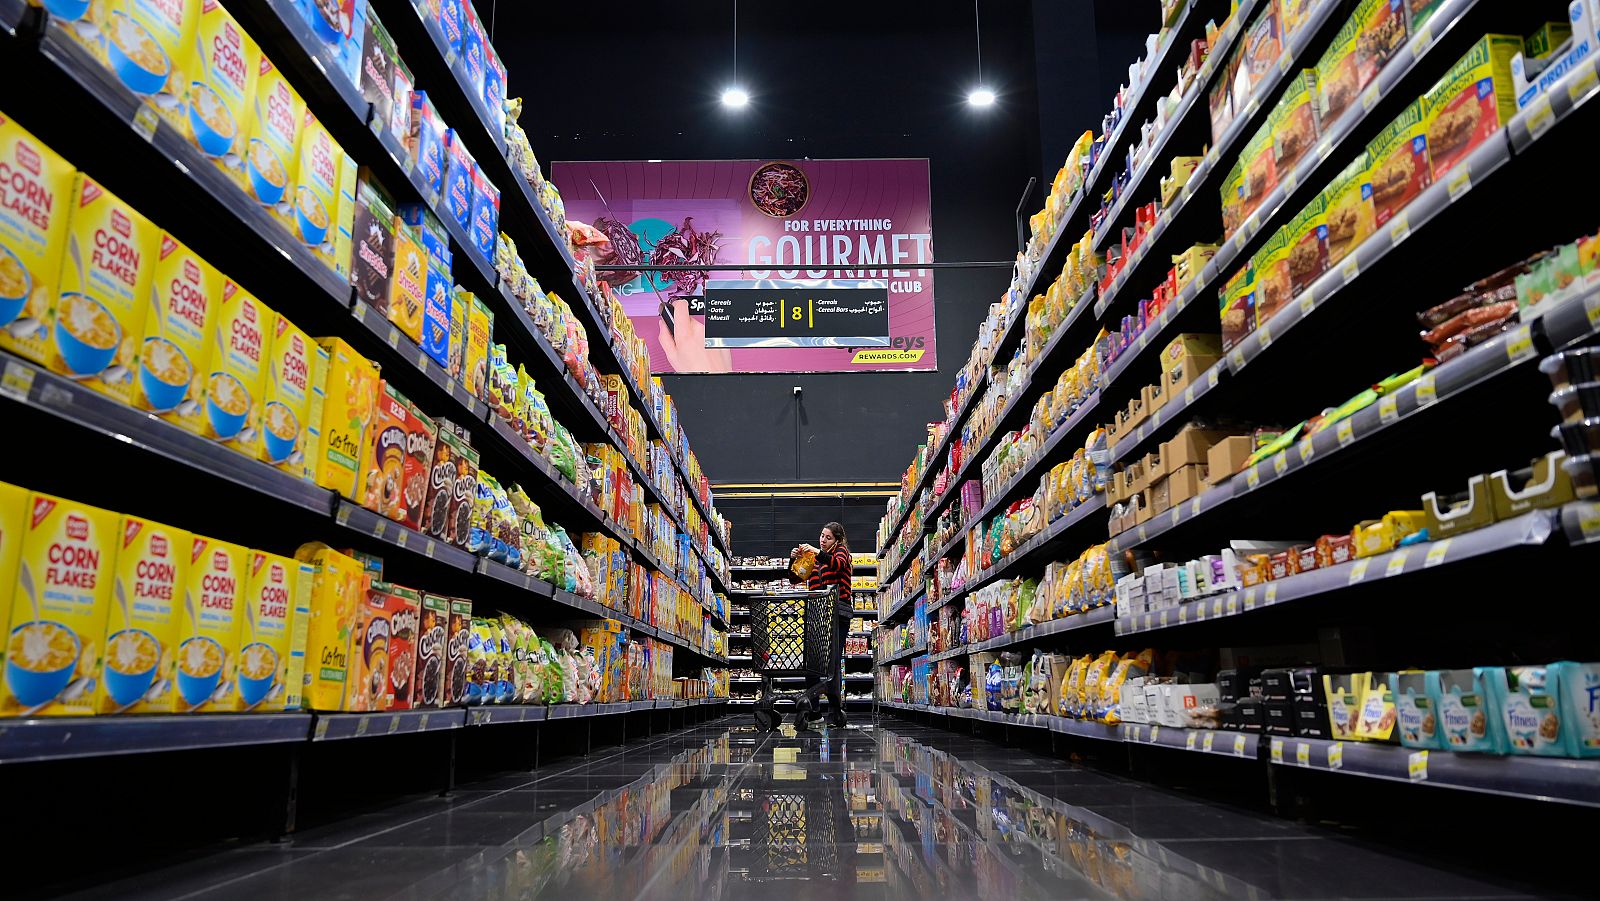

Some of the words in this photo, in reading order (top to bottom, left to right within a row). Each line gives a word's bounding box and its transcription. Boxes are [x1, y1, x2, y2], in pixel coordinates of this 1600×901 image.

[214, 35, 246, 79] CORN
[1539, 40, 1589, 90] PROTEIN
[213, 52, 245, 91] FLAKES
[268, 95, 295, 132] CORN
[312, 144, 335, 178] CORN
[0, 162, 52, 213] CORN
[785, 221, 809, 231] FOR
[814, 219, 892, 231] EVERYTHING
[95, 228, 139, 270] CORN
[749, 233, 930, 279] GOURMET
[92, 249, 136, 287] FLAKES
[171, 278, 207, 313] CORN
[891, 281, 922, 293] CLUB
[169, 297, 205, 328] FLAKES
[792, 306, 802, 320] 8
[232, 318, 262, 348] CORN
[231, 335, 259, 362] FLAKES
[284, 351, 308, 379] CORN
[283, 367, 306, 391] FLAKES
[48, 543, 99, 570] CORN
[46, 568, 96, 589] FLAKES
[136, 560, 175, 583] CORN
[202, 574, 235, 595] CORN
[135, 582, 172, 600] FLAKES
[201, 594, 233, 610] FLAKES
[261, 586, 289, 604] CORN
[260, 604, 286, 618] FLAKES
[1400, 708, 1420, 724] Fitness
[1444, 709, 1469, 725] Fitness
[1508, 709, 1537, 727] Fitness
